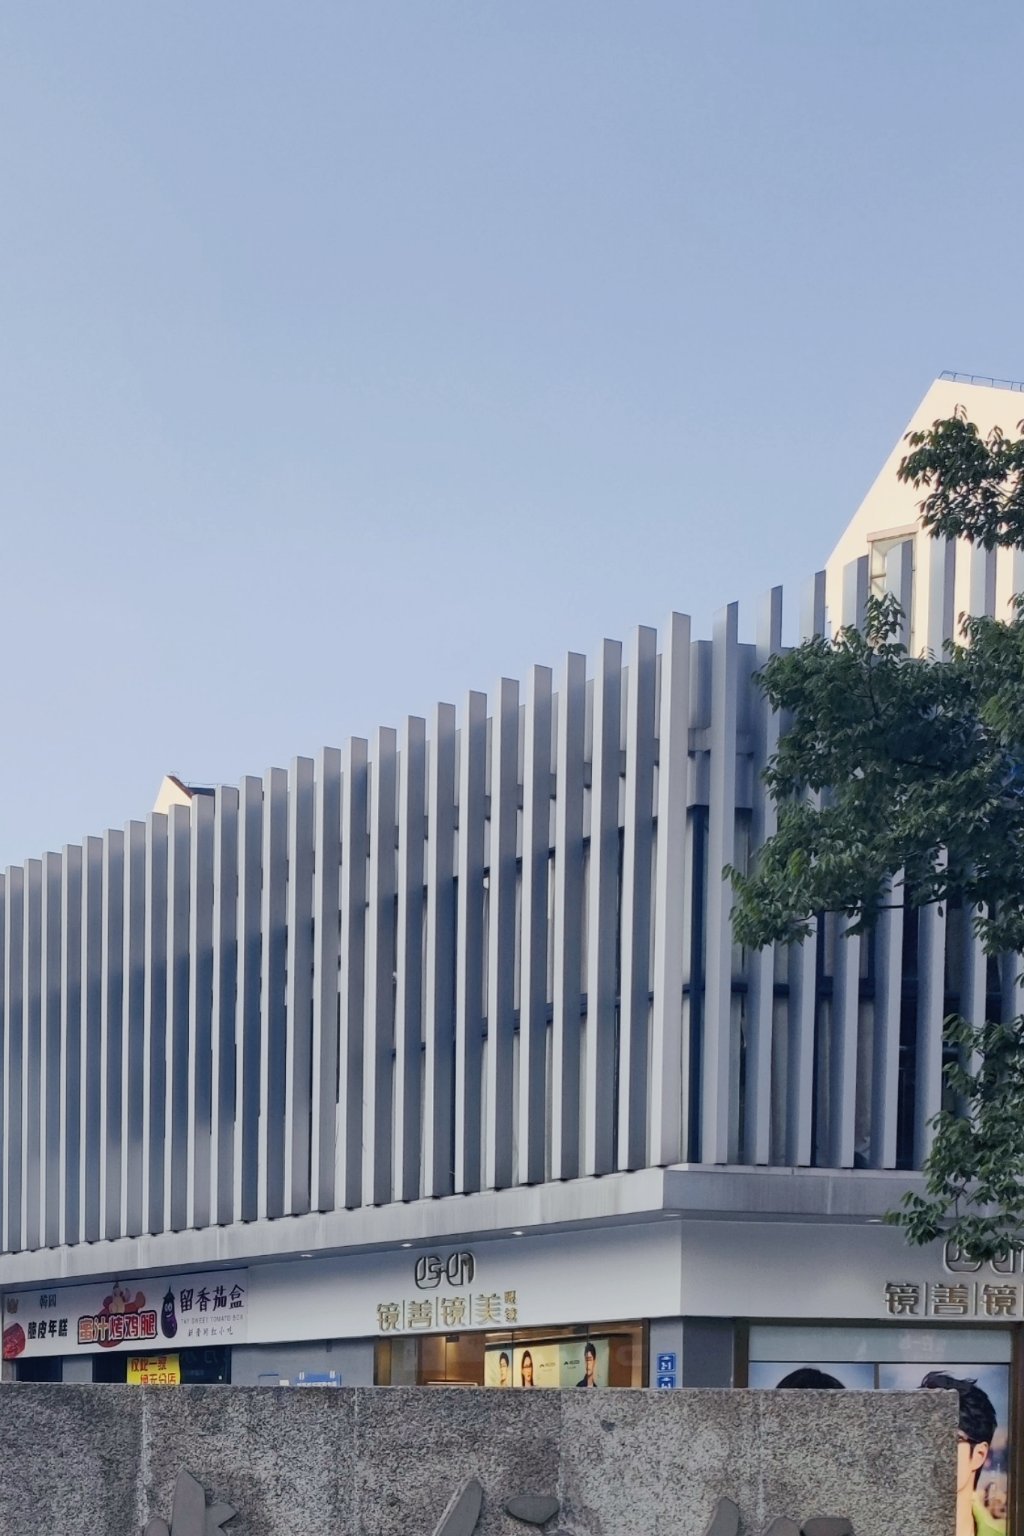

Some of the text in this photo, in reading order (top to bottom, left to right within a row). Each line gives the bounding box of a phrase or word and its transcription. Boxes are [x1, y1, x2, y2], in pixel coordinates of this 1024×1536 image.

[180, 1284, 245, 1313] 留香茄盒
[28, 1318, 68, 1340] 脆皮年糕
[79, 1311, 157, 1343] 蜜汁烤鸡腿
